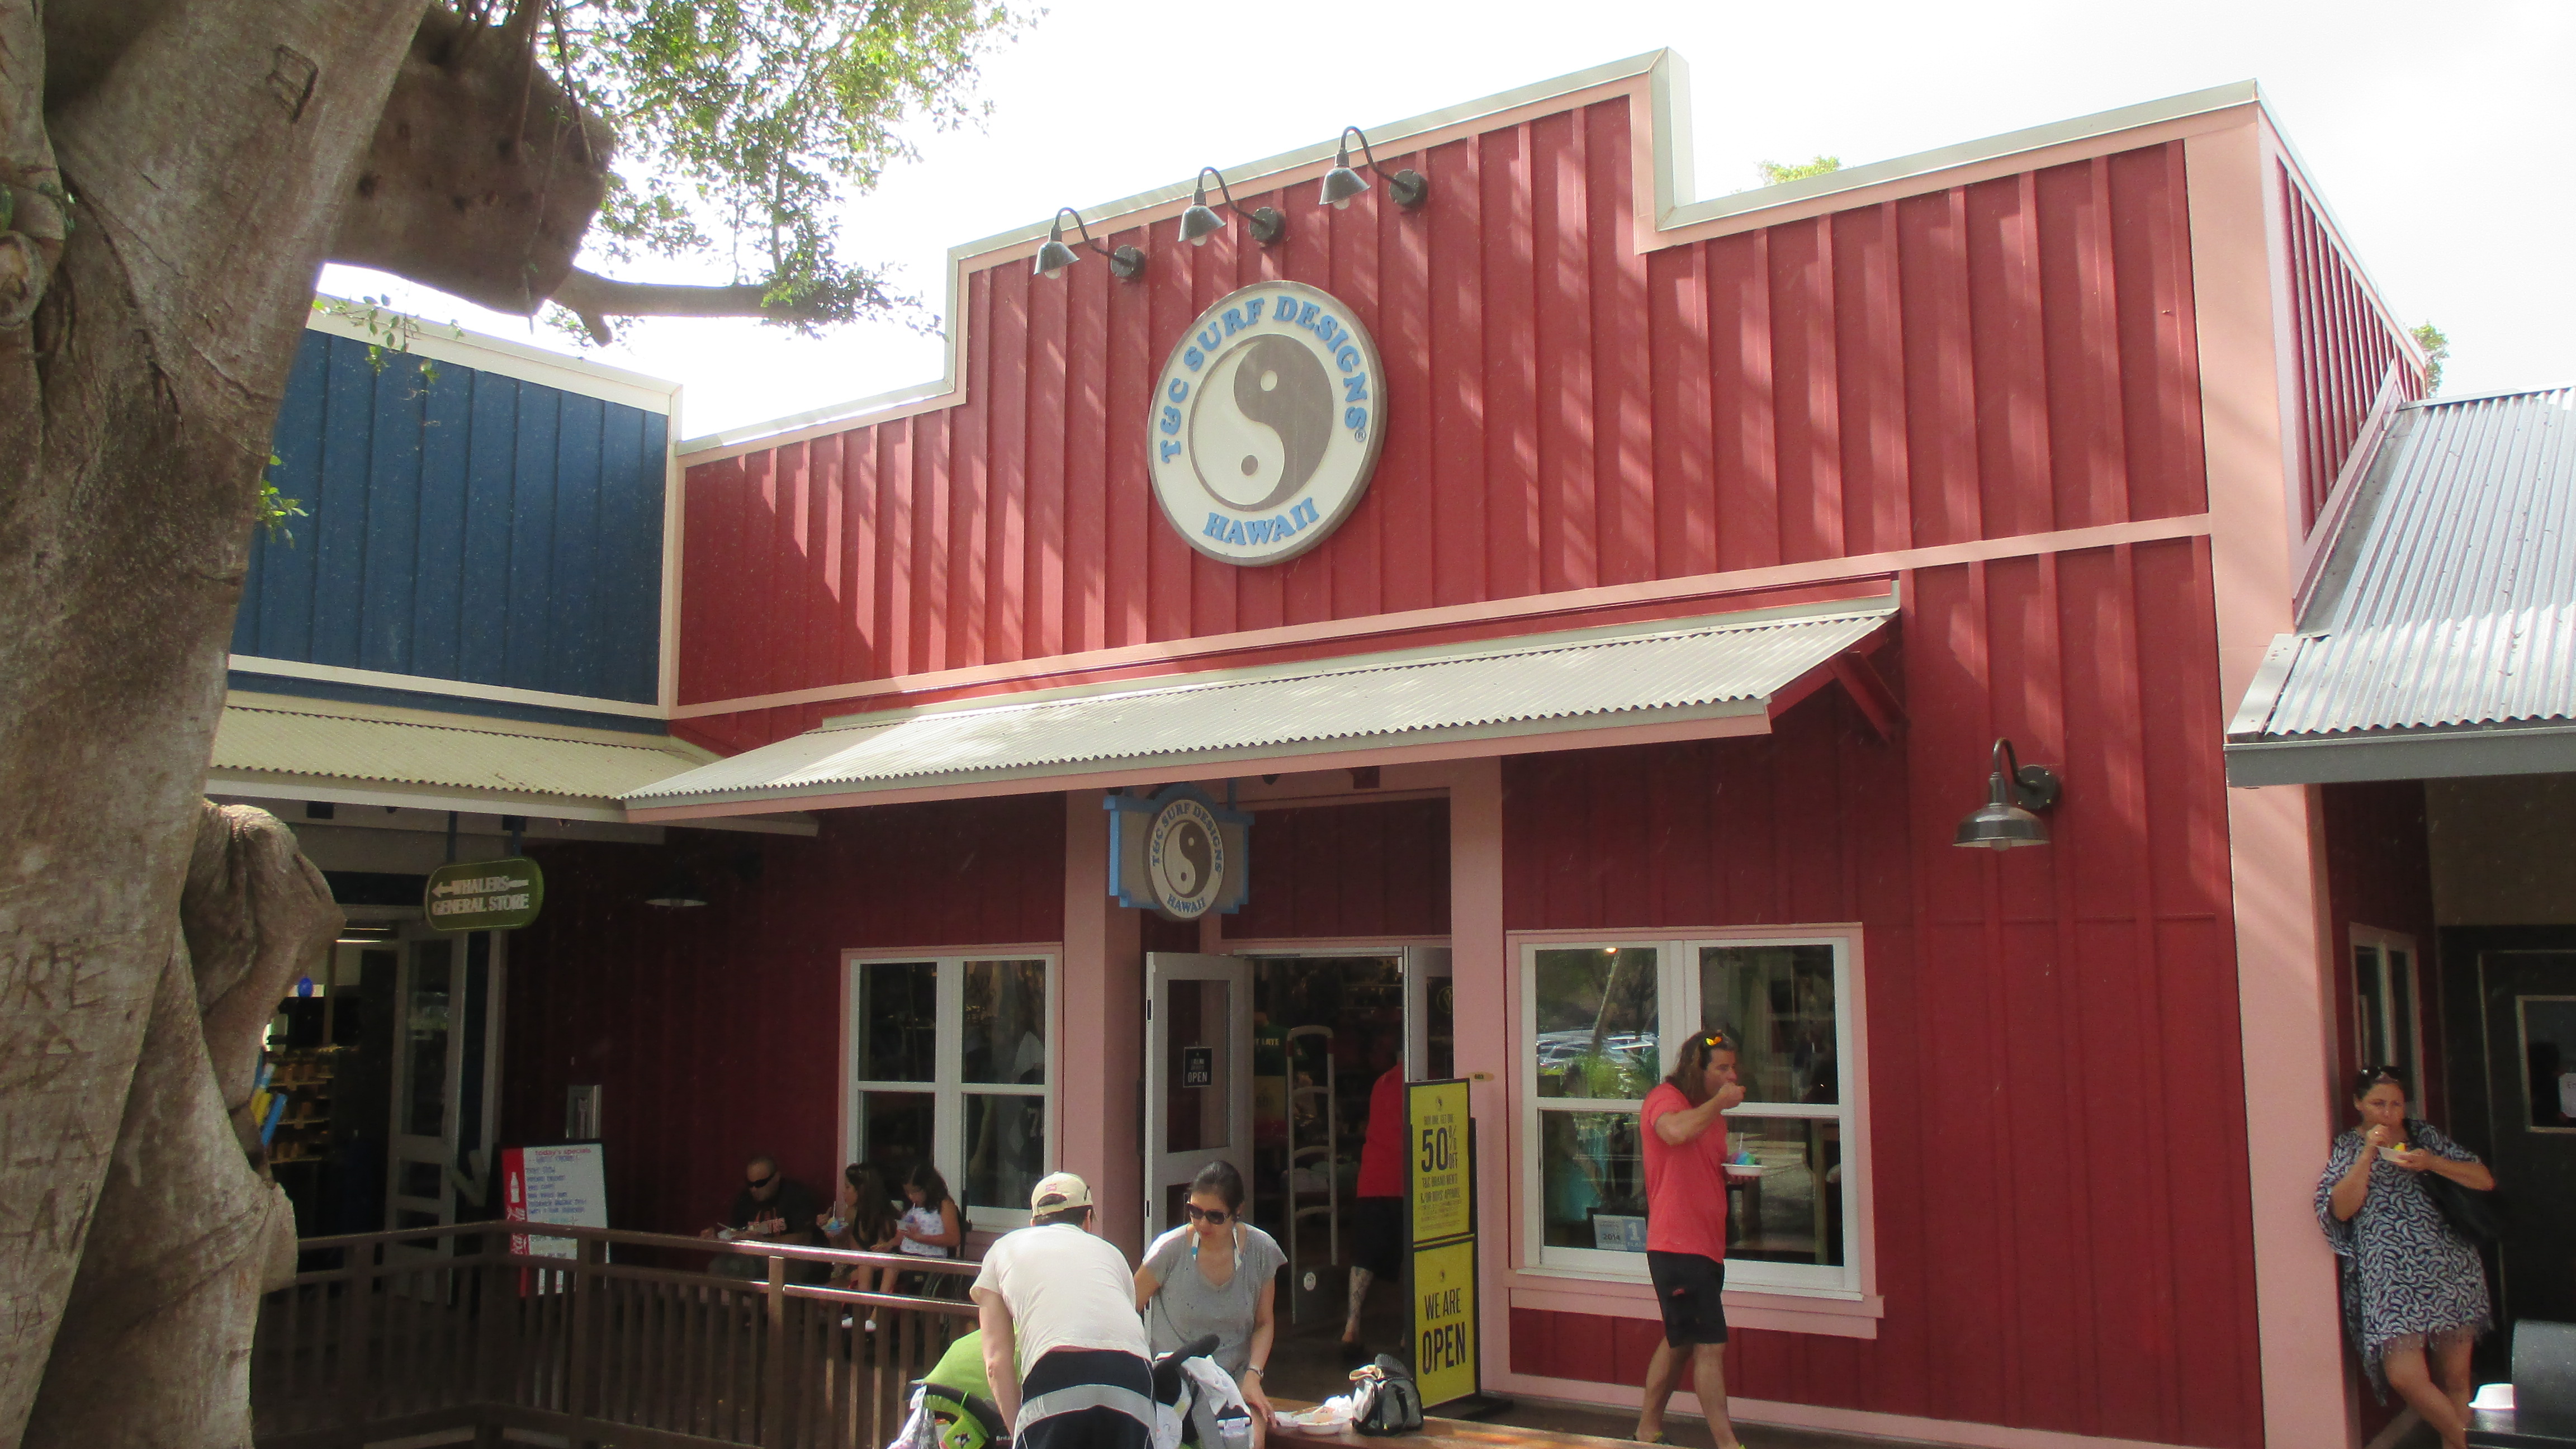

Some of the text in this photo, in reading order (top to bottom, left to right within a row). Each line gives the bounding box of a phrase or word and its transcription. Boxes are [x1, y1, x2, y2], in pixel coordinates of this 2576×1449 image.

[1160, 296, 1367, 463] T&C SURF DESIGNS
[1202, 497, 1320, 546] HAWAII
[1151, 803, 1223, 873] T&C SURF DESIGNS
[432, 893, 530, 915] GENERAL STORE
[1167, 894, 1206, 913] HAWAII
[1188, 1072, 1208, 1082] OPEN
[1448, 1152, 1458, 1169] OFF
[1424, 1288, 1461, 1320] WE ARE
[1422, 1322, 1466, 1375] OPEN
